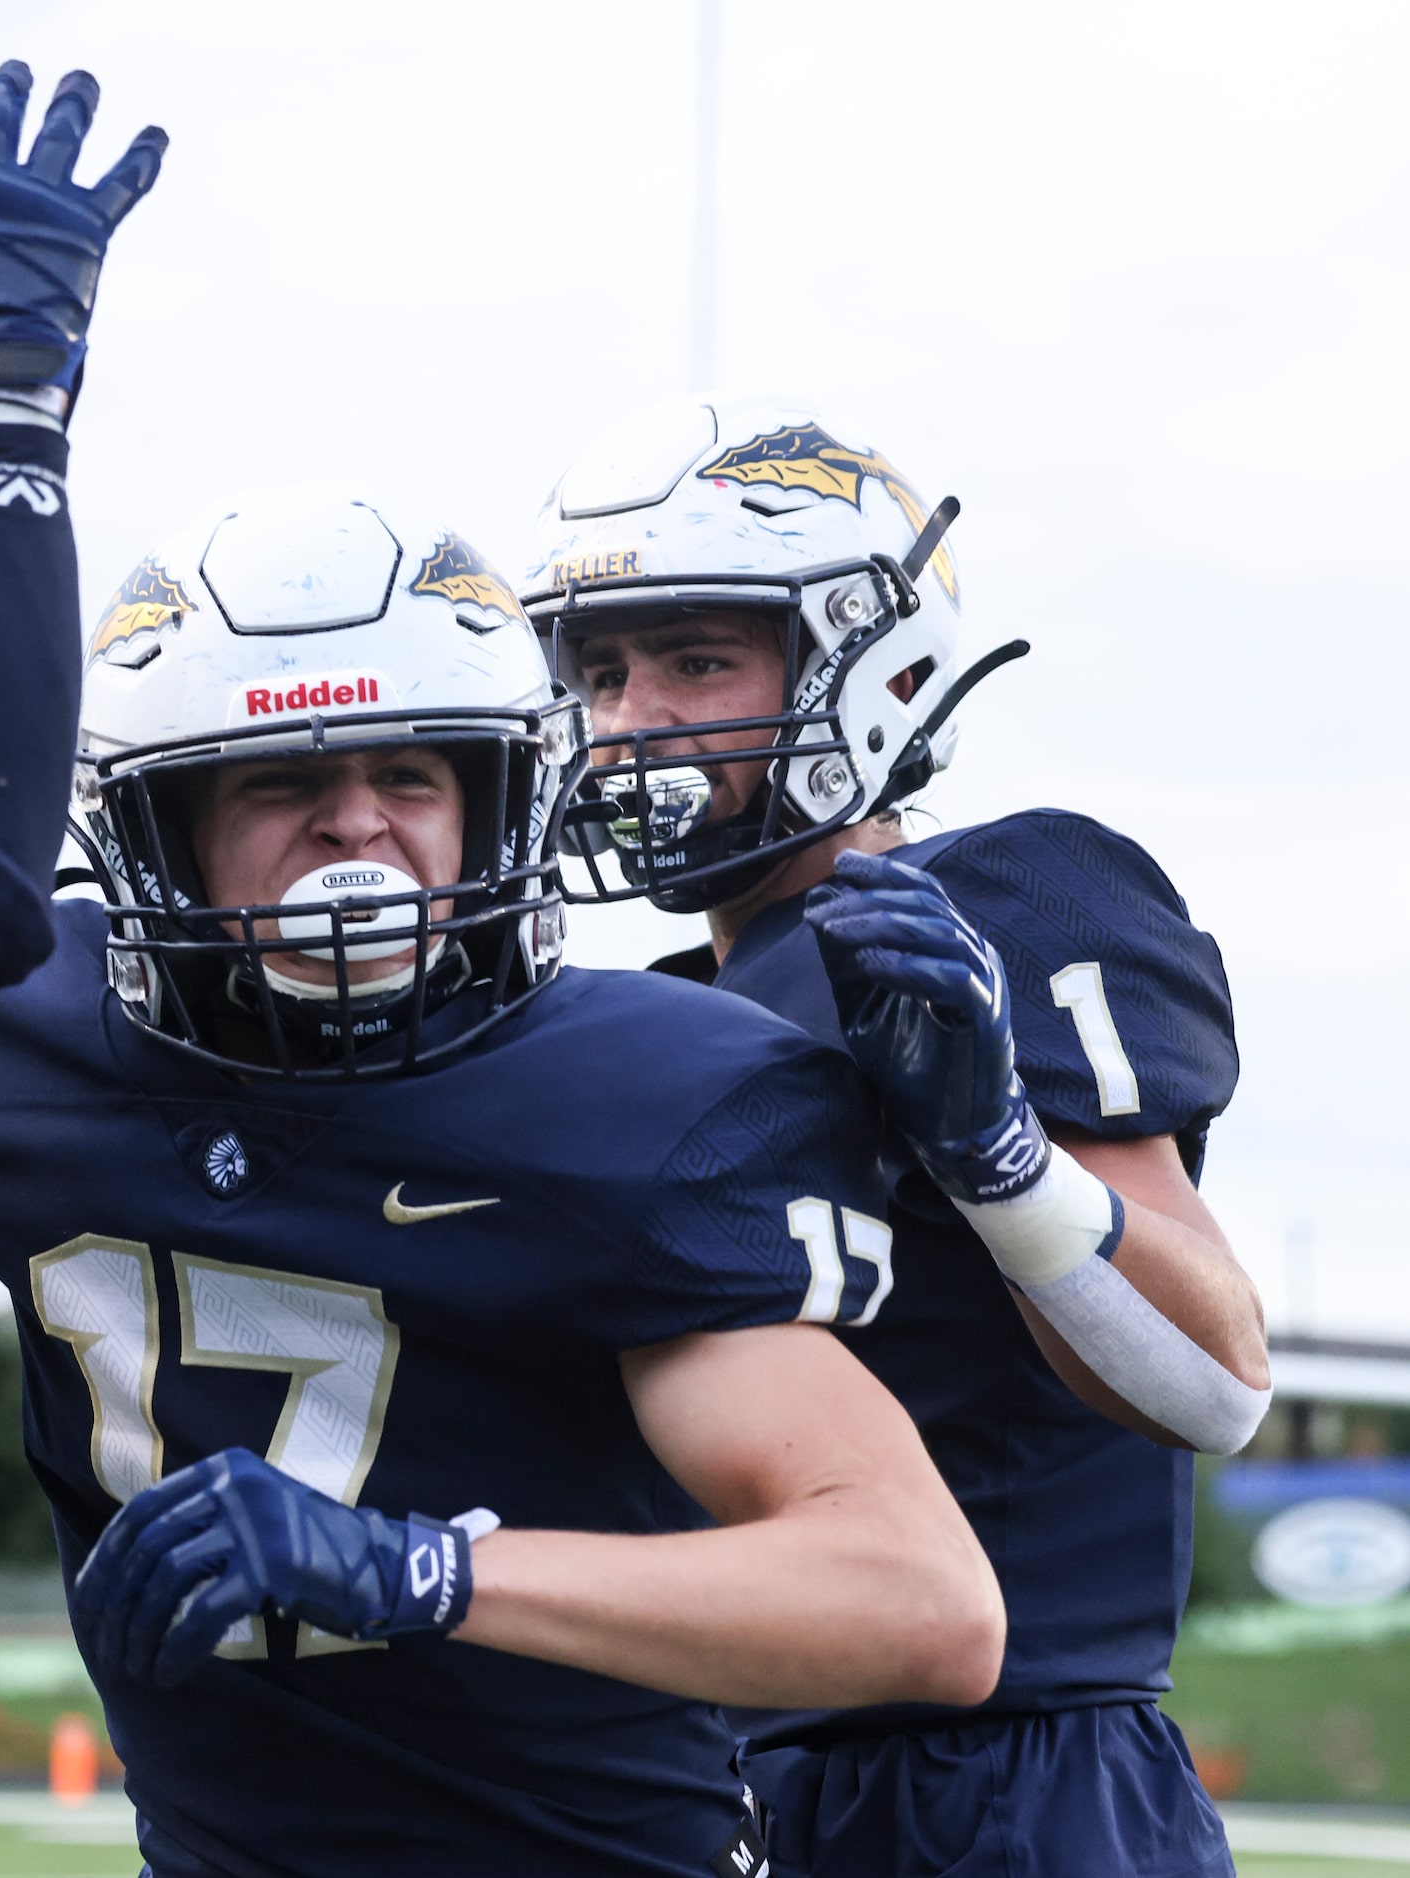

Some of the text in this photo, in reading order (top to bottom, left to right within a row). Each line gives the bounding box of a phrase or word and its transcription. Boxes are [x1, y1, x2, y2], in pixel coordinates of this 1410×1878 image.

[552, 549, 641, 586] KELLER
[246, 677, 378, 716] Riddell
[329, 874, 379, 885] BATTLE
[1049, 961, 1141, 1117] 1
[786, 1195, 894, 1327] 17
[30, 1232, 399, 1659] 17
[433, 1532, 457, 1624] CUTTERS
